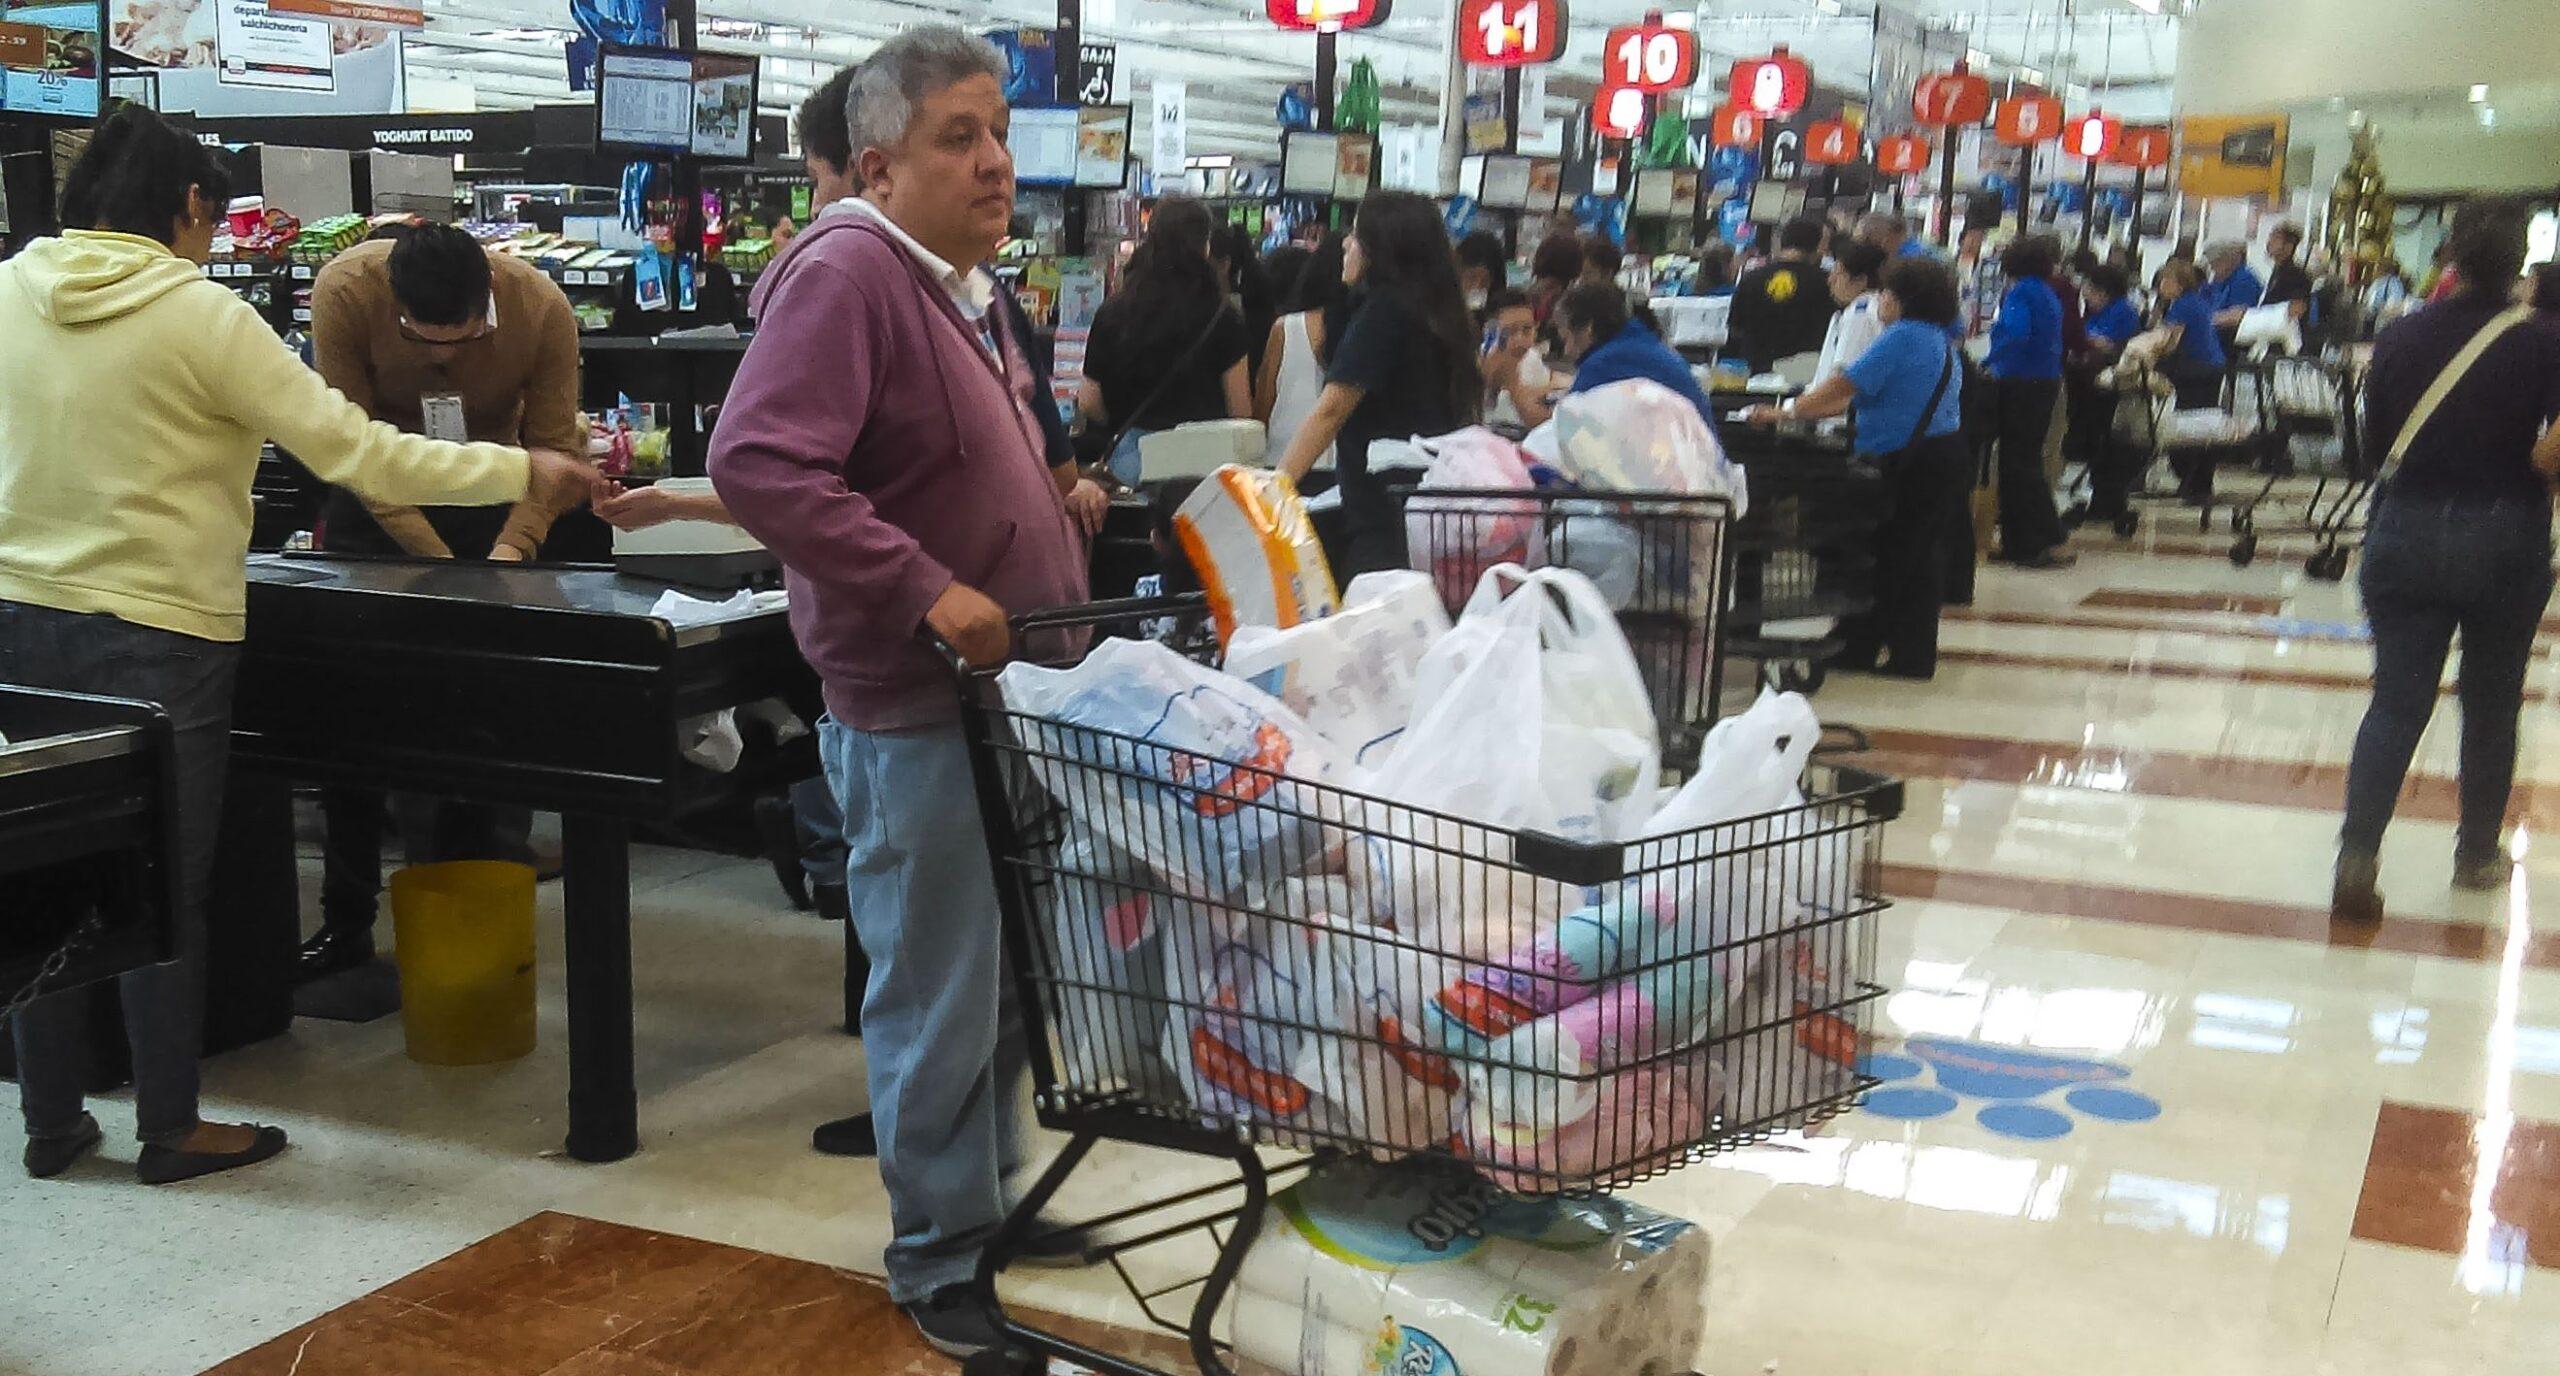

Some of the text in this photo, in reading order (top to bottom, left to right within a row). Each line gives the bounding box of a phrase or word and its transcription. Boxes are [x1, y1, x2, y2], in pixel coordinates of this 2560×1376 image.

[234, 5, 266, 17] depart
[1478, 1, 1539, 55] 11
[1619, 33, 1679, 85] 10
[37, 70, 68, 86] 20%
[373, 128, 473, 143] YOGHURT BATIDO
